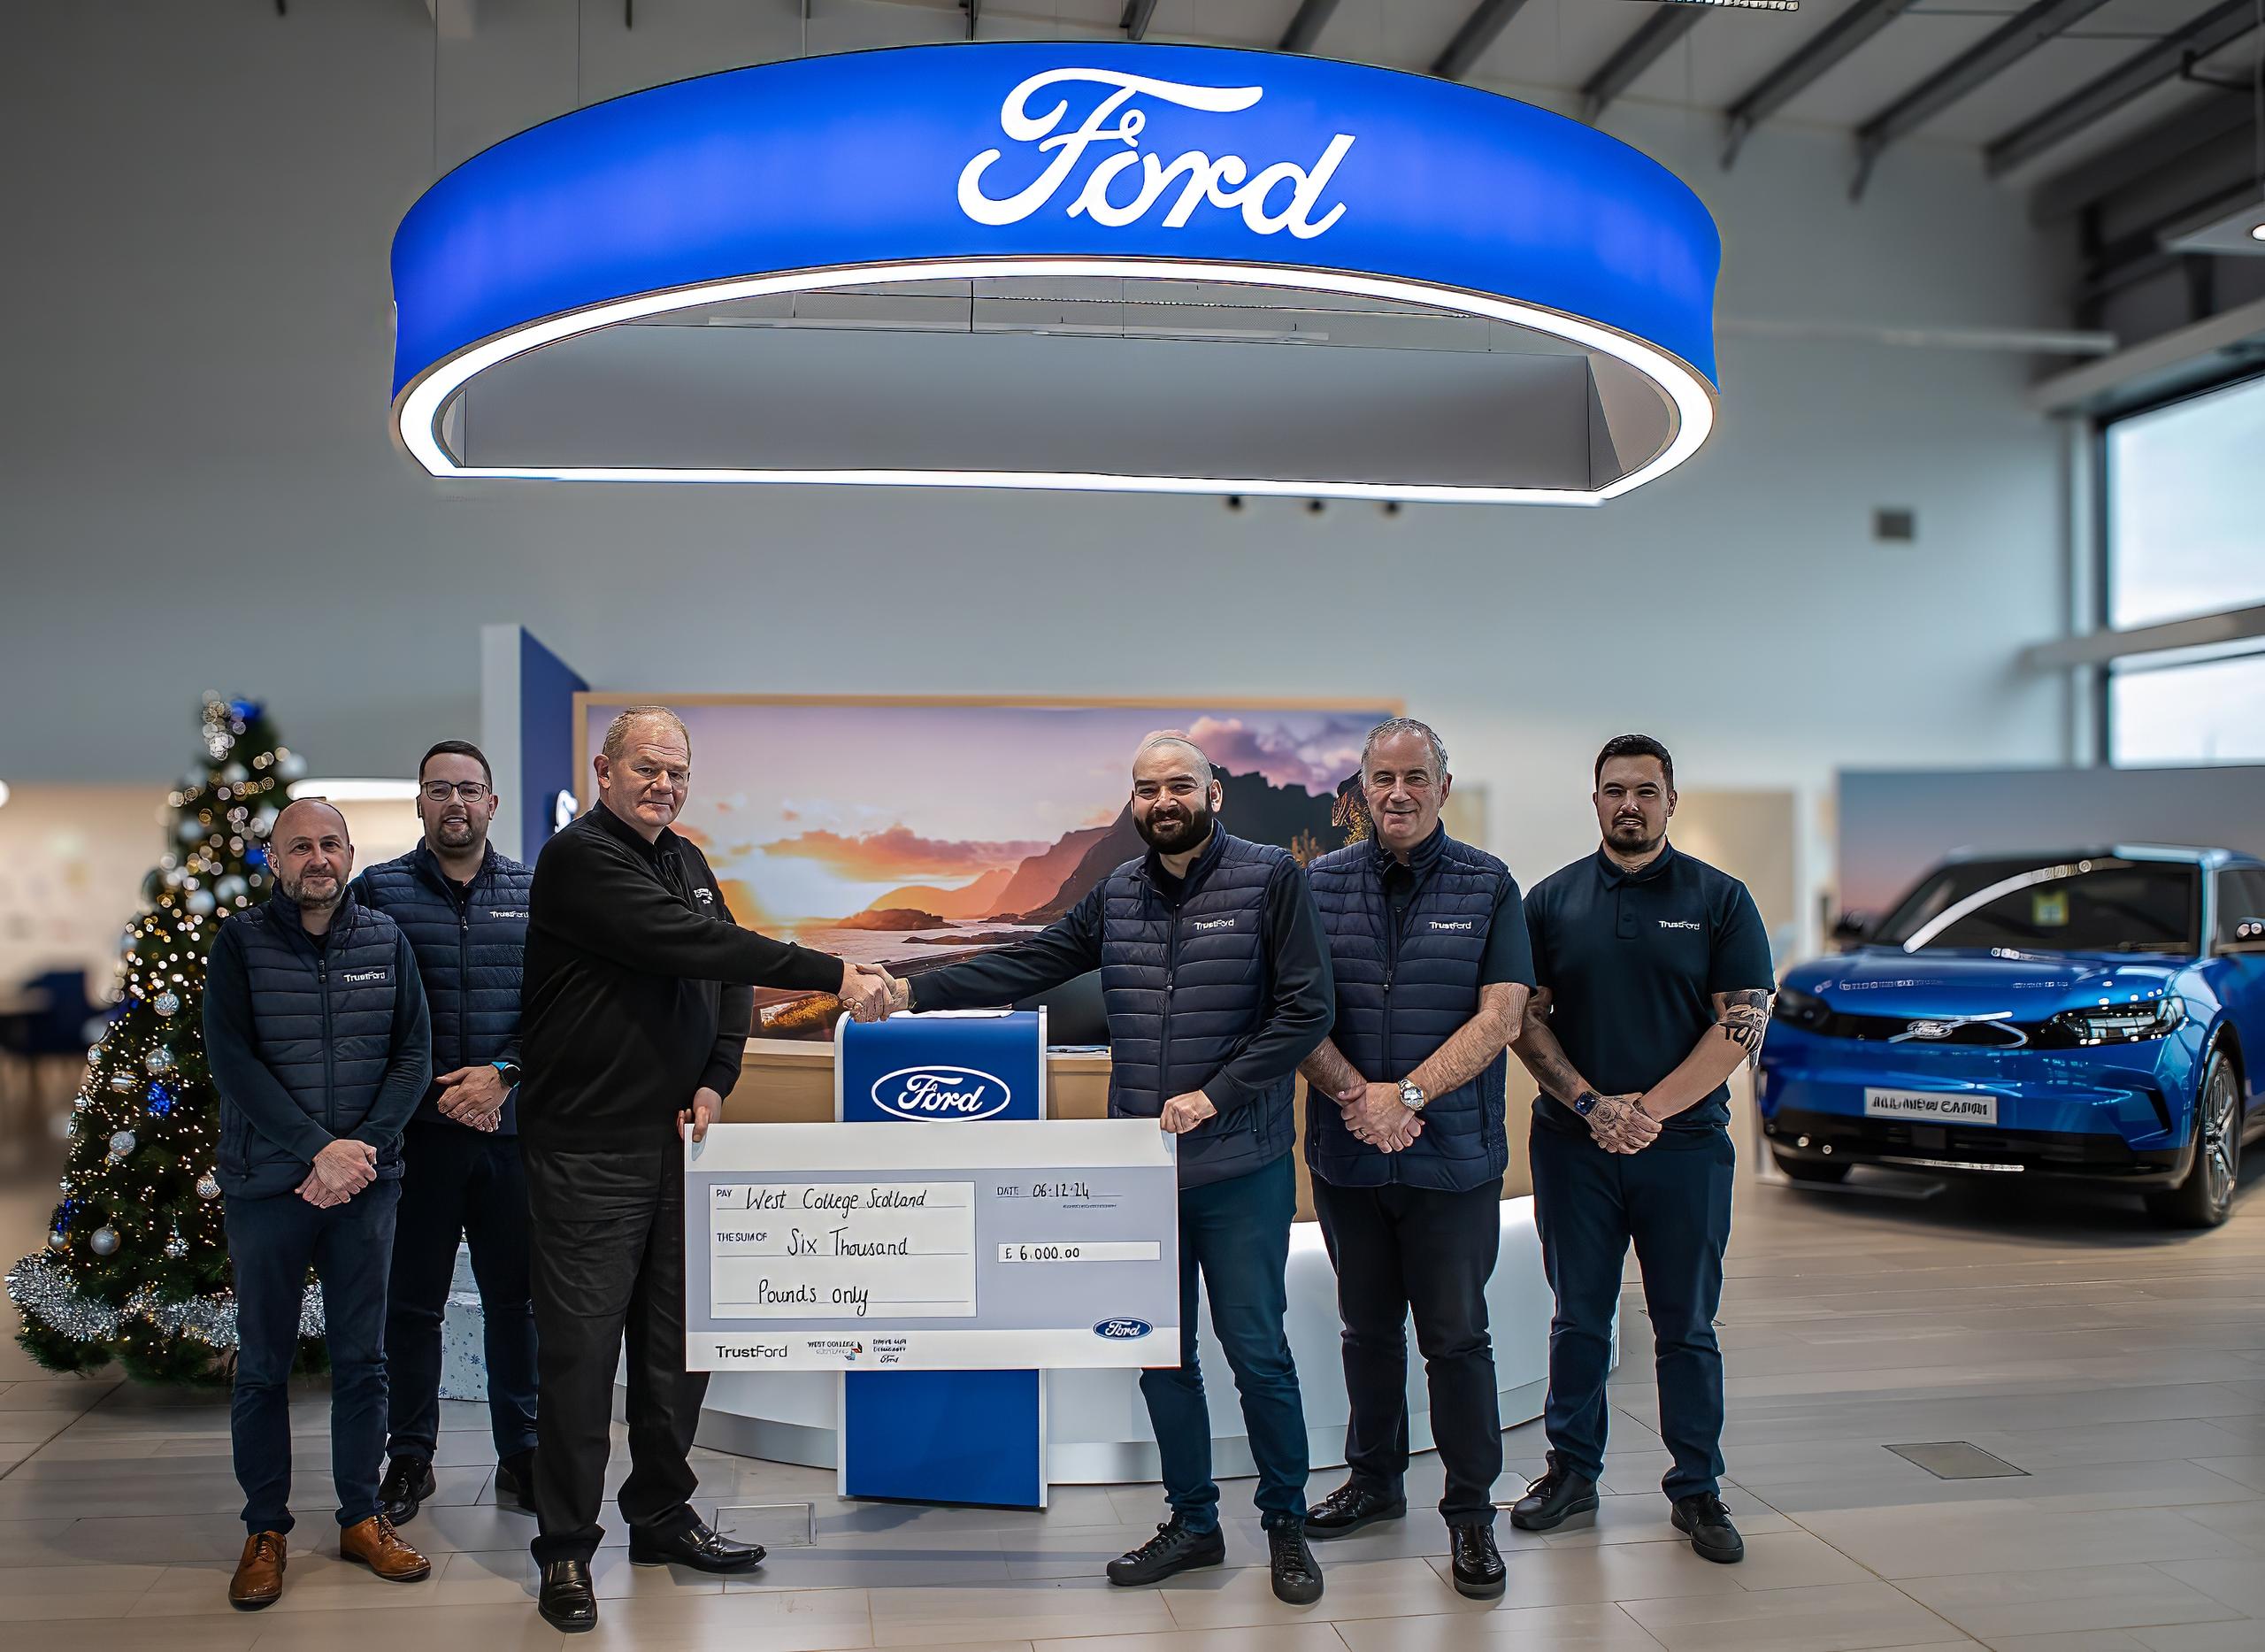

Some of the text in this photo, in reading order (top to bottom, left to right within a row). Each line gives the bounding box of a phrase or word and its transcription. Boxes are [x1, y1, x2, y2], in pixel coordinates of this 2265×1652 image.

[957, 67, 1356, 240] Ford
[1428, 921, 1472, 930] TrustFord
[897, 1074, 986, 1112] Ford
[716, 1189, 733, 1198] PAY
[996, 1186, 1020, 1196] DATE
[746, 1187, 787, 1210] West
[802, 1187, 859, 1218] College
[717, 1233, 768, 1242] THE SUM OF
[787, 1226, 909, 1256] Six Thousand
[758, 1279, 869, 1317] Pounds only
[1104, 1320, 1141, 1337] Ford
[715, 1345, 788, 1358] TrustFord
